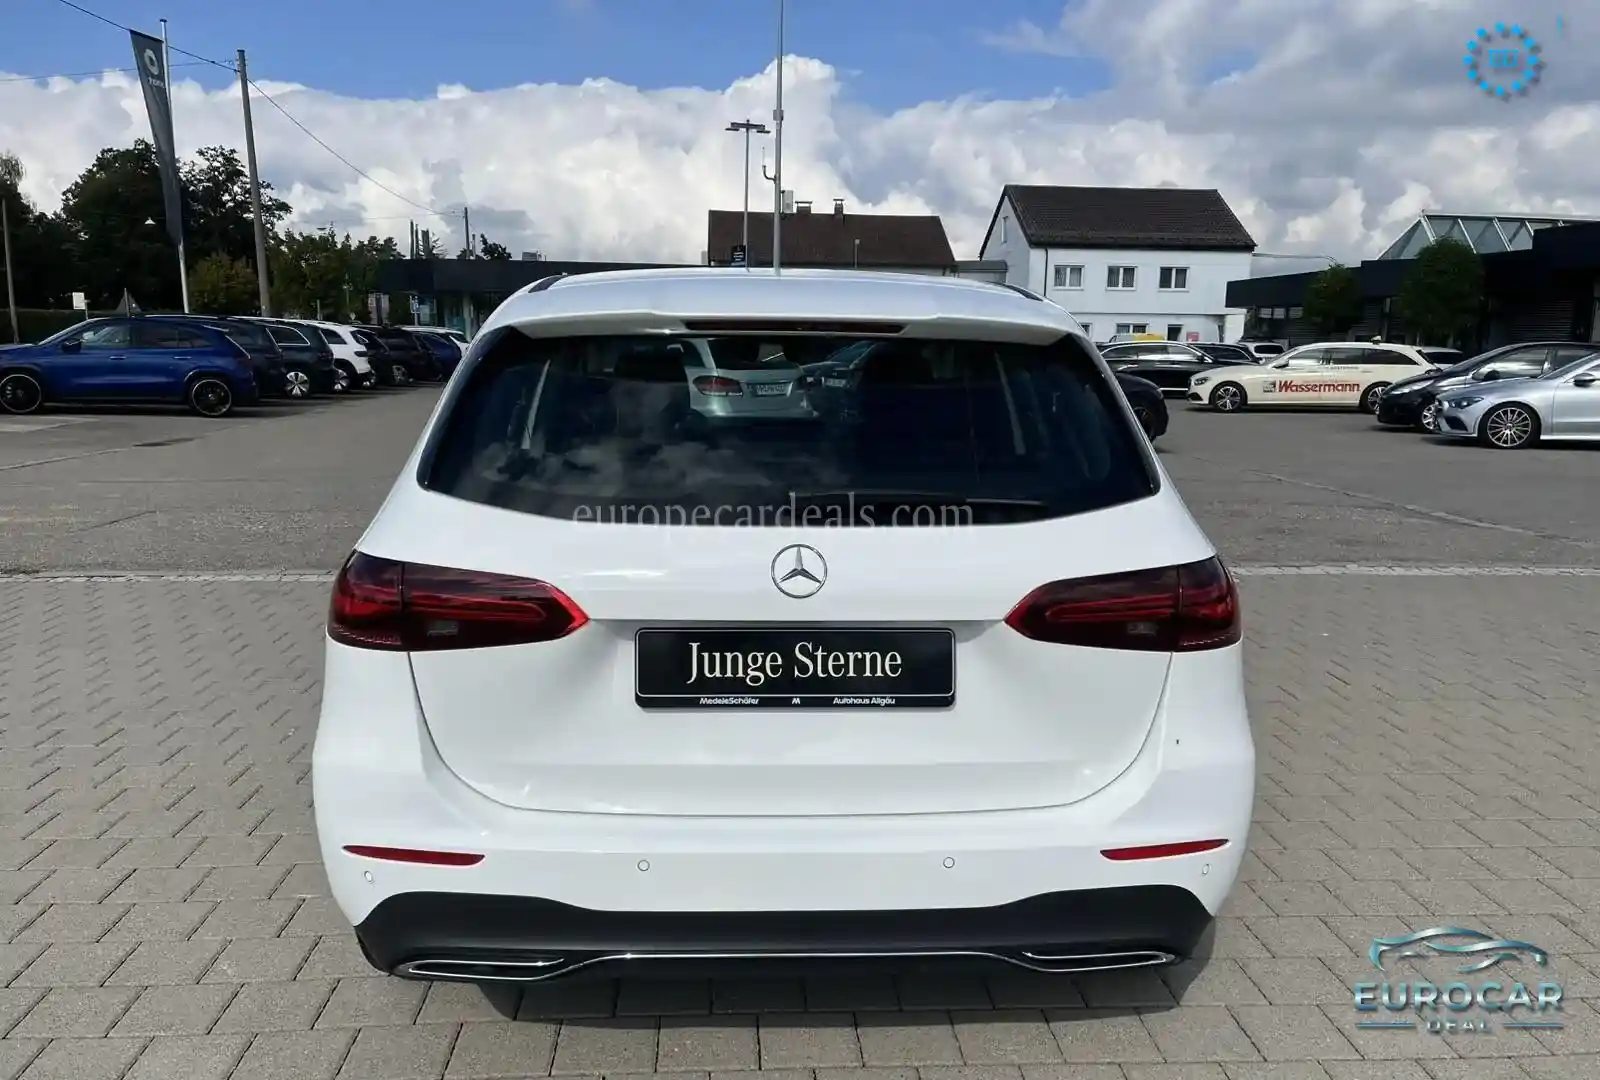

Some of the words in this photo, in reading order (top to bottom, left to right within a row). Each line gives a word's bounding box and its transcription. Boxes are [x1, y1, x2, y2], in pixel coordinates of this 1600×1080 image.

[1278, 379, 1360, 393] Wassermann
[686, 641, 783, 687] Junge
[794, 641, 902, 678] Sterne
[833, 697, 870, 705] Autohaus
